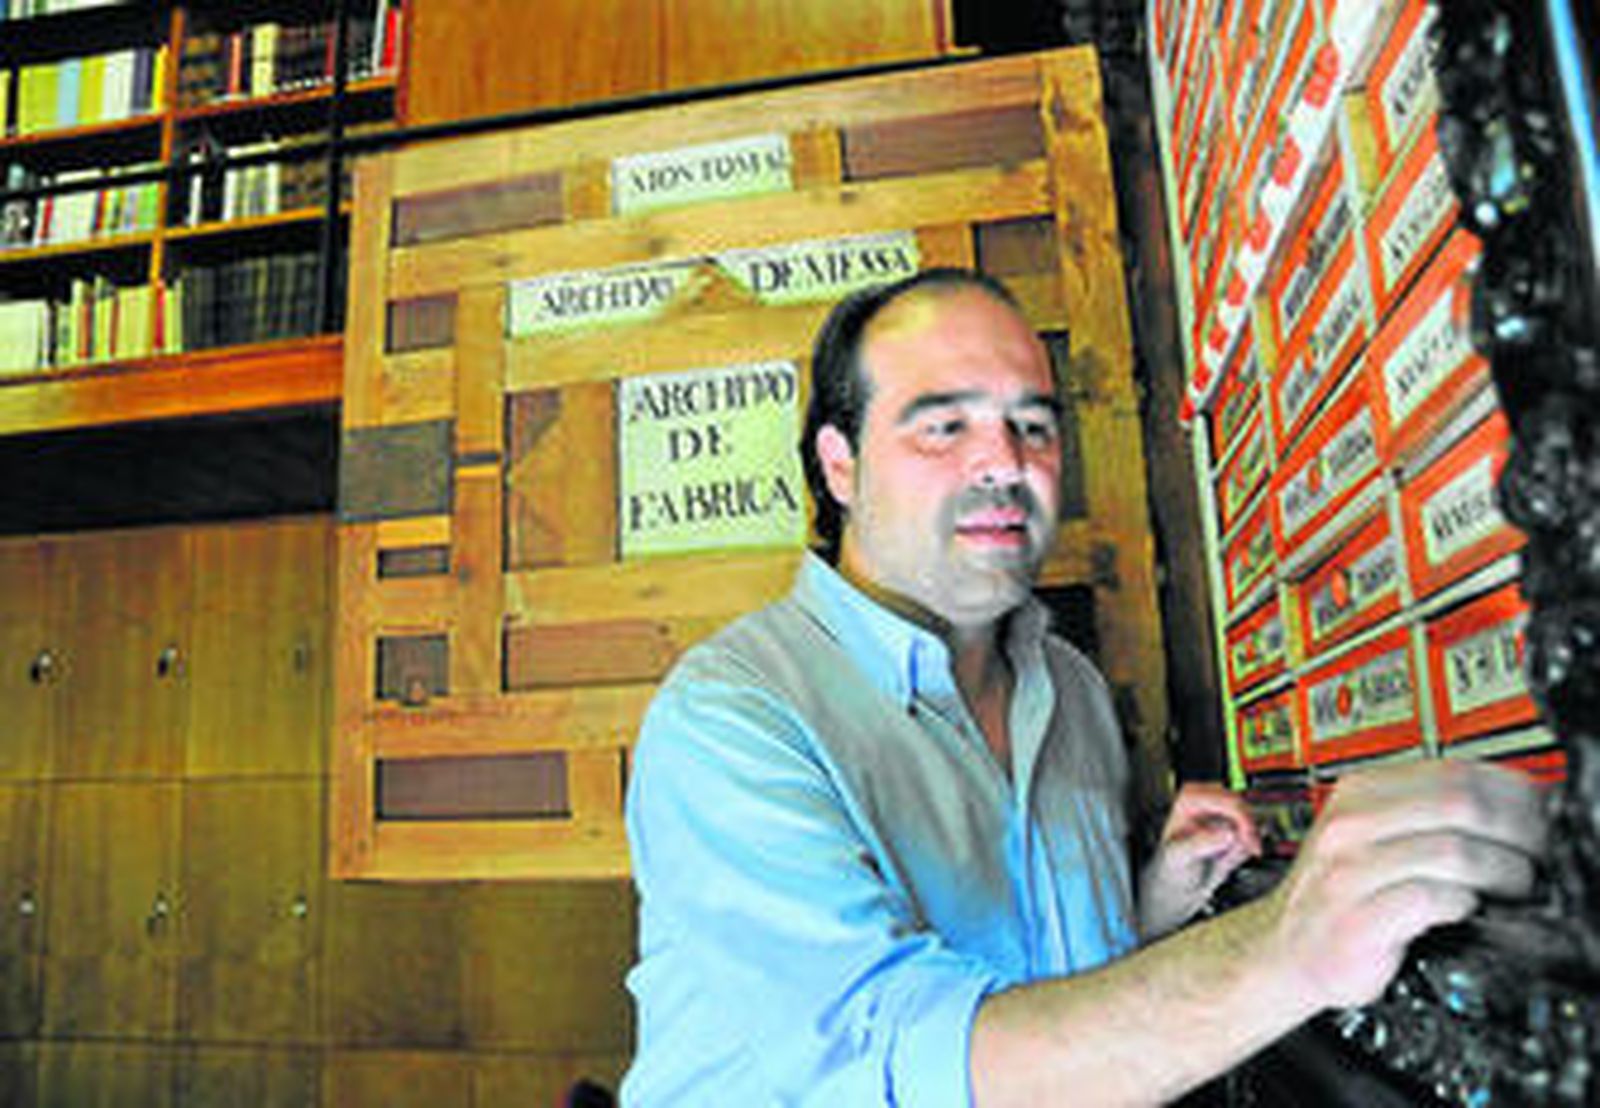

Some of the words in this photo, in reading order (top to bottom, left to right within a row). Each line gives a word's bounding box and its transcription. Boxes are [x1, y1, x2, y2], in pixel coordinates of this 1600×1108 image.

[628, 368, 796, 421] ARCHIVO
[667, 424, 734, 461] DE
[628, 475, 798, 530] FABRICA
